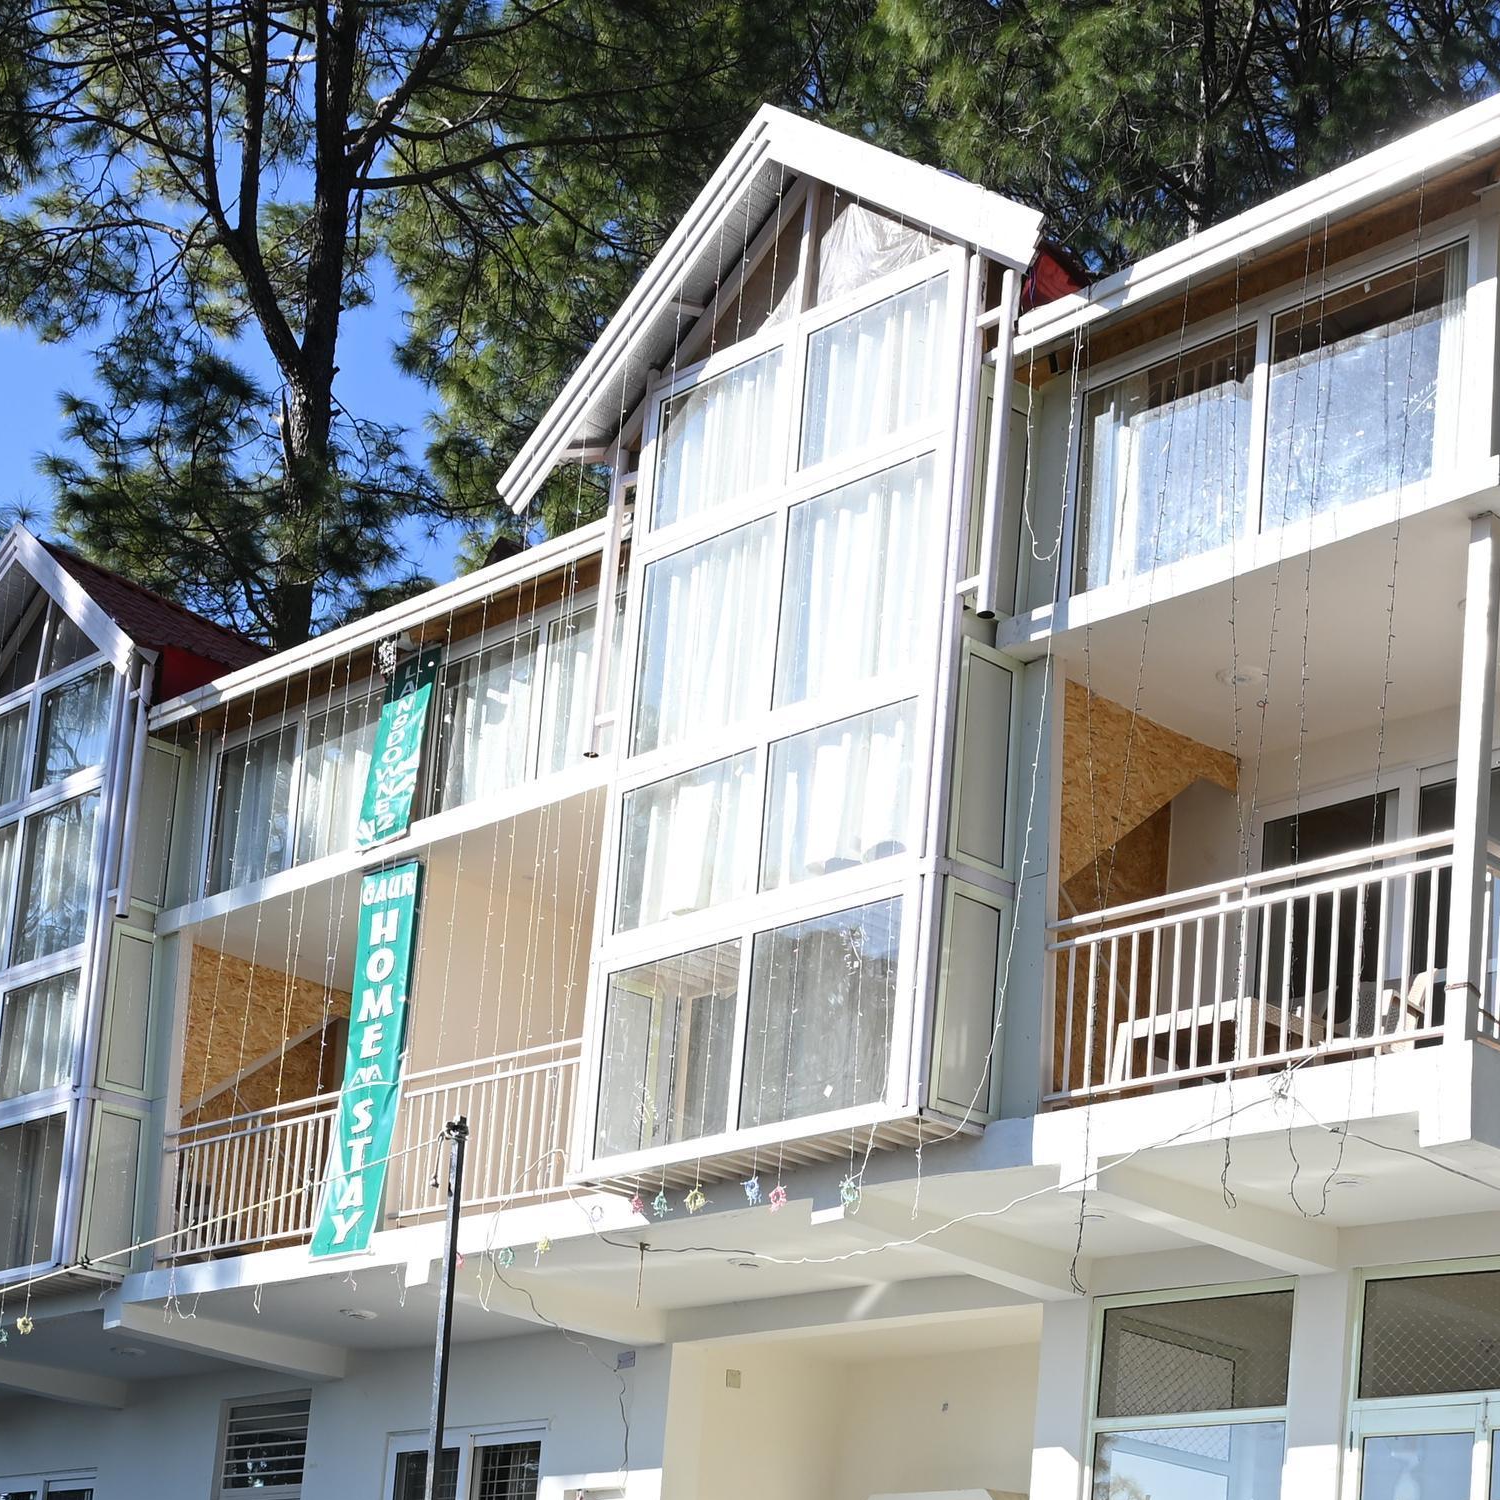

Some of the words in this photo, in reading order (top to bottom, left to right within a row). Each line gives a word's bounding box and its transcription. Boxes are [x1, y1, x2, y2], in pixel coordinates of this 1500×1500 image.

[362, 871, 415, 907] GAUR
[356, 907, 400, 1060] HOME
[330, 1098, 374, 1247] STAY
